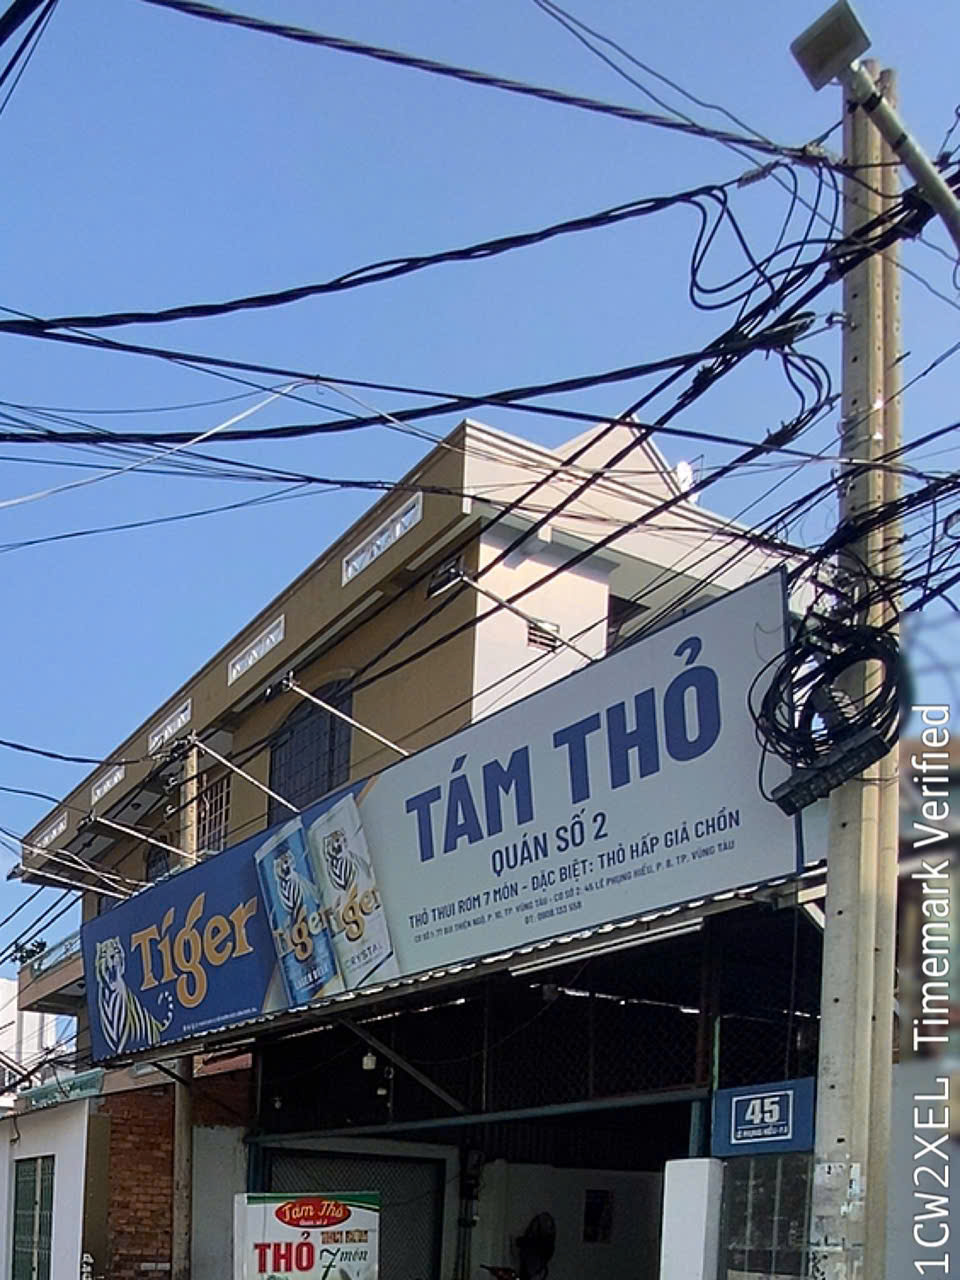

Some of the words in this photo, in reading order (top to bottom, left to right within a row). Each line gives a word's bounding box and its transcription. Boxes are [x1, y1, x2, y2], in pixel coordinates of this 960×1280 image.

[405, 745, 534, 863] TÁM
[553, 636, 721, 804] THỎ
[432, 902, 456, 922] THUI
[483, 891, 490, 906] 7
[531, 870, 556, 893] ĐẶC
[630, 831, 660, 860] HẤP
[491, 833, 549, 877] QUÁN
[555, 808, 586, 851] SỐ
[593, 812, 609, 840] 2
[131, 892, 258, 1009] Tiger
[745, 1097, 780, 1124] 45
[254, 1231, 315, 1274] THỎ
[319, 1247, 341, 1280] 7
